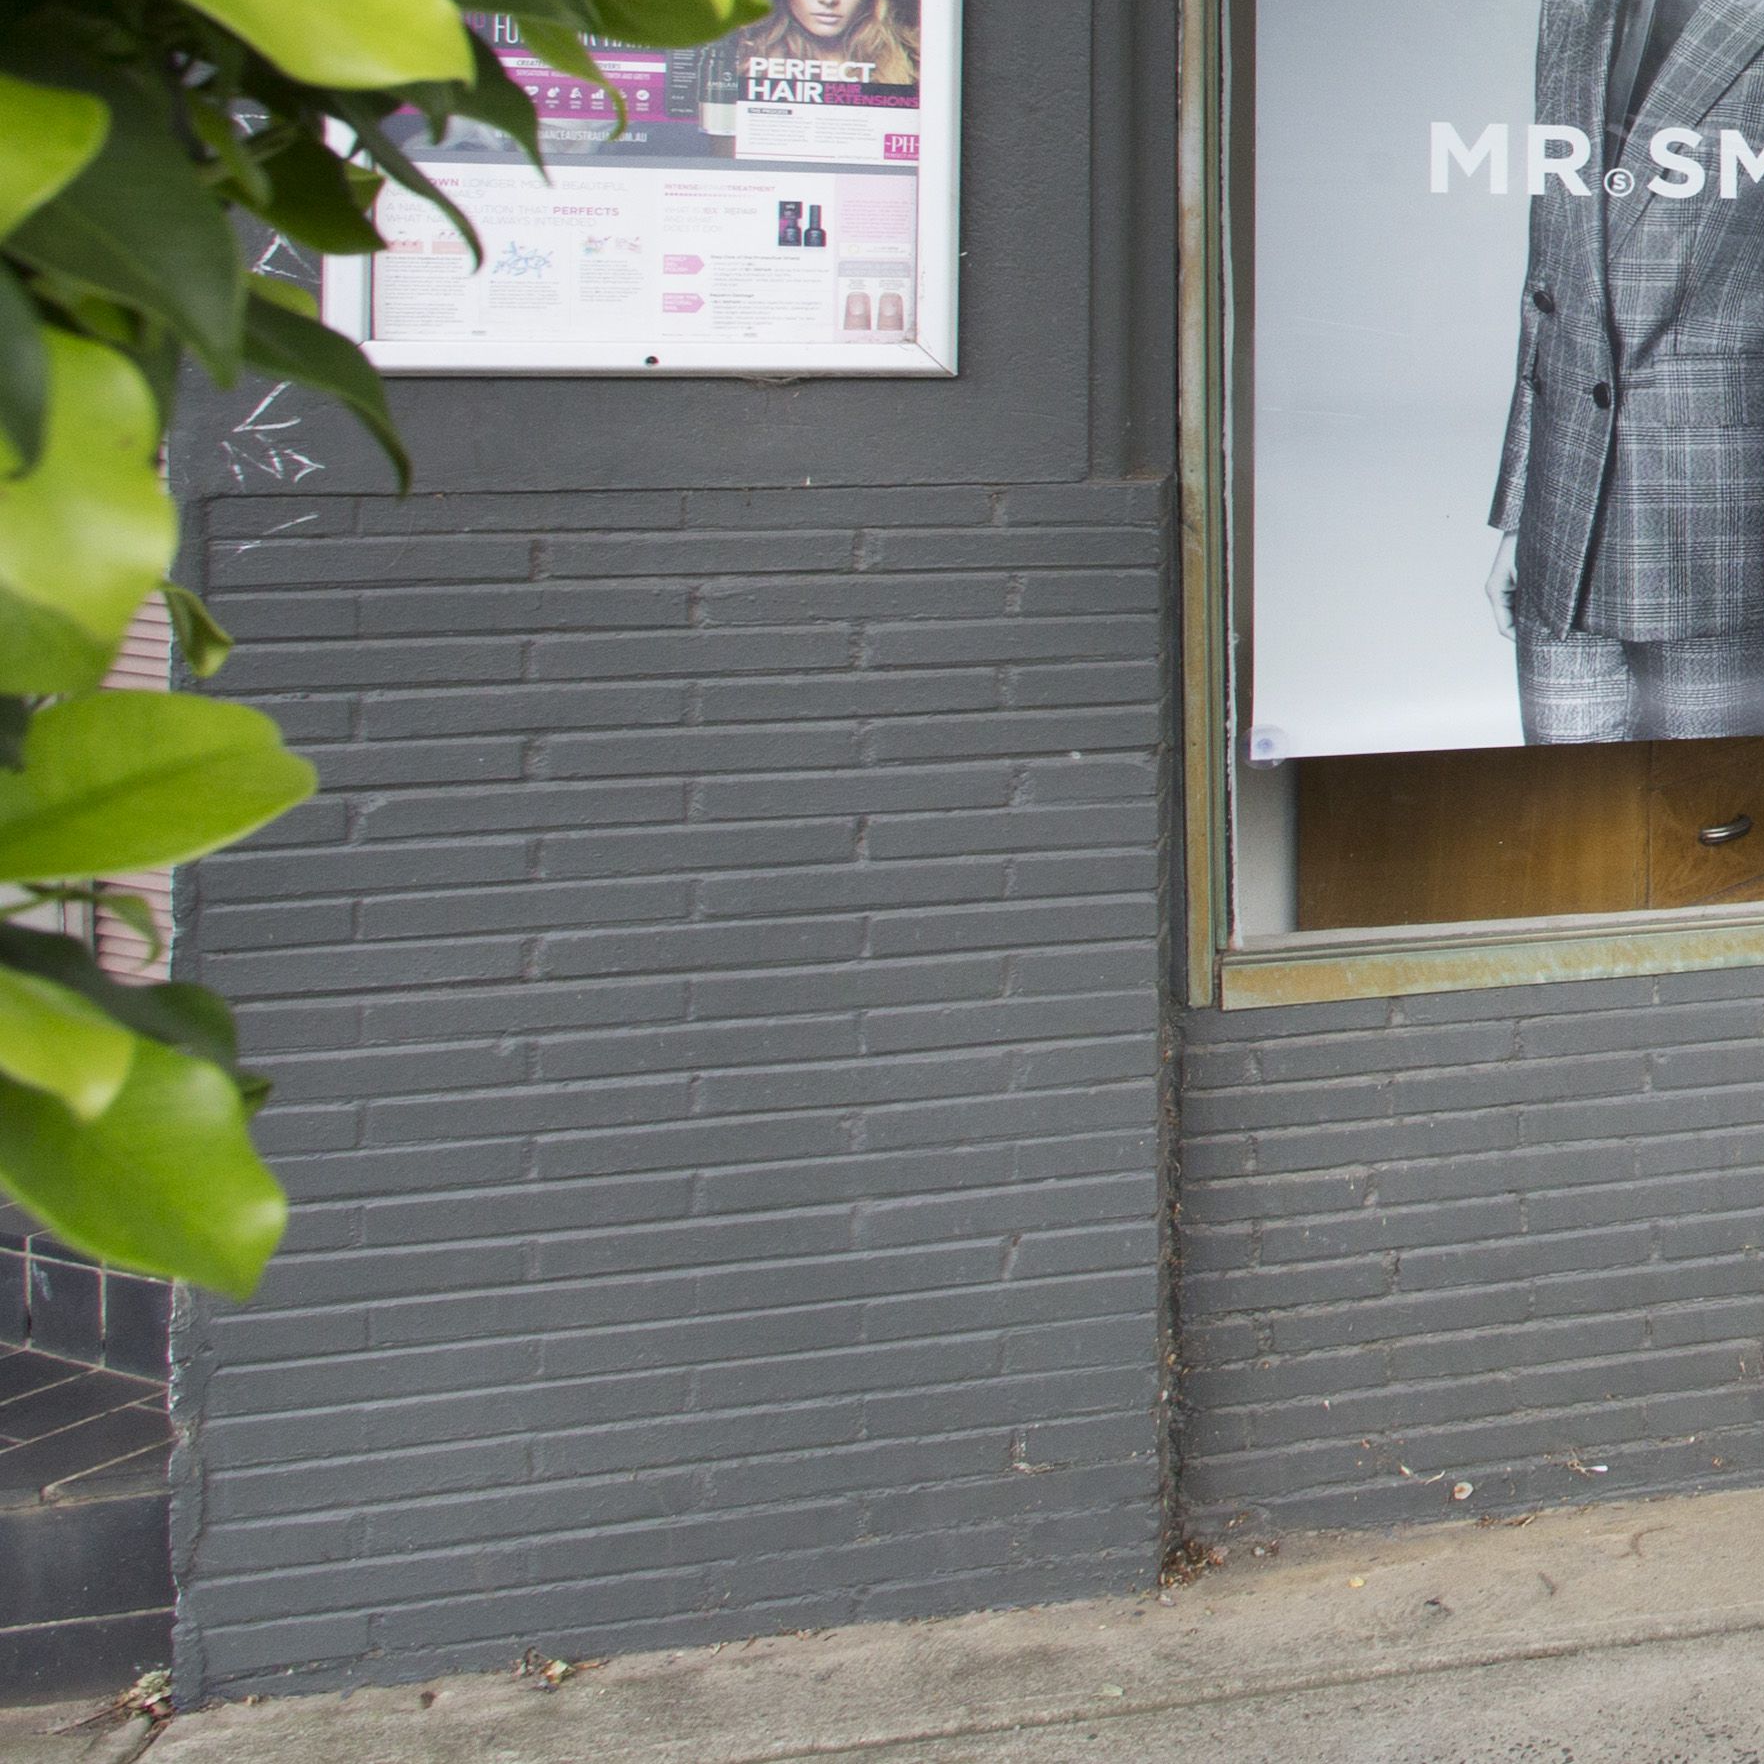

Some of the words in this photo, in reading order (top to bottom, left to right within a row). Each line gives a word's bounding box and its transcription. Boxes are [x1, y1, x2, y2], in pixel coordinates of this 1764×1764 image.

[750, 57, 876, 83] PERFECT
[748, 79, 823, 103] HAIR
[824, 84, 861, 95] HAIR
[823, 95, 919, 108] EXTENSIONS
[553, 207, 620, 217] PERFECTS
